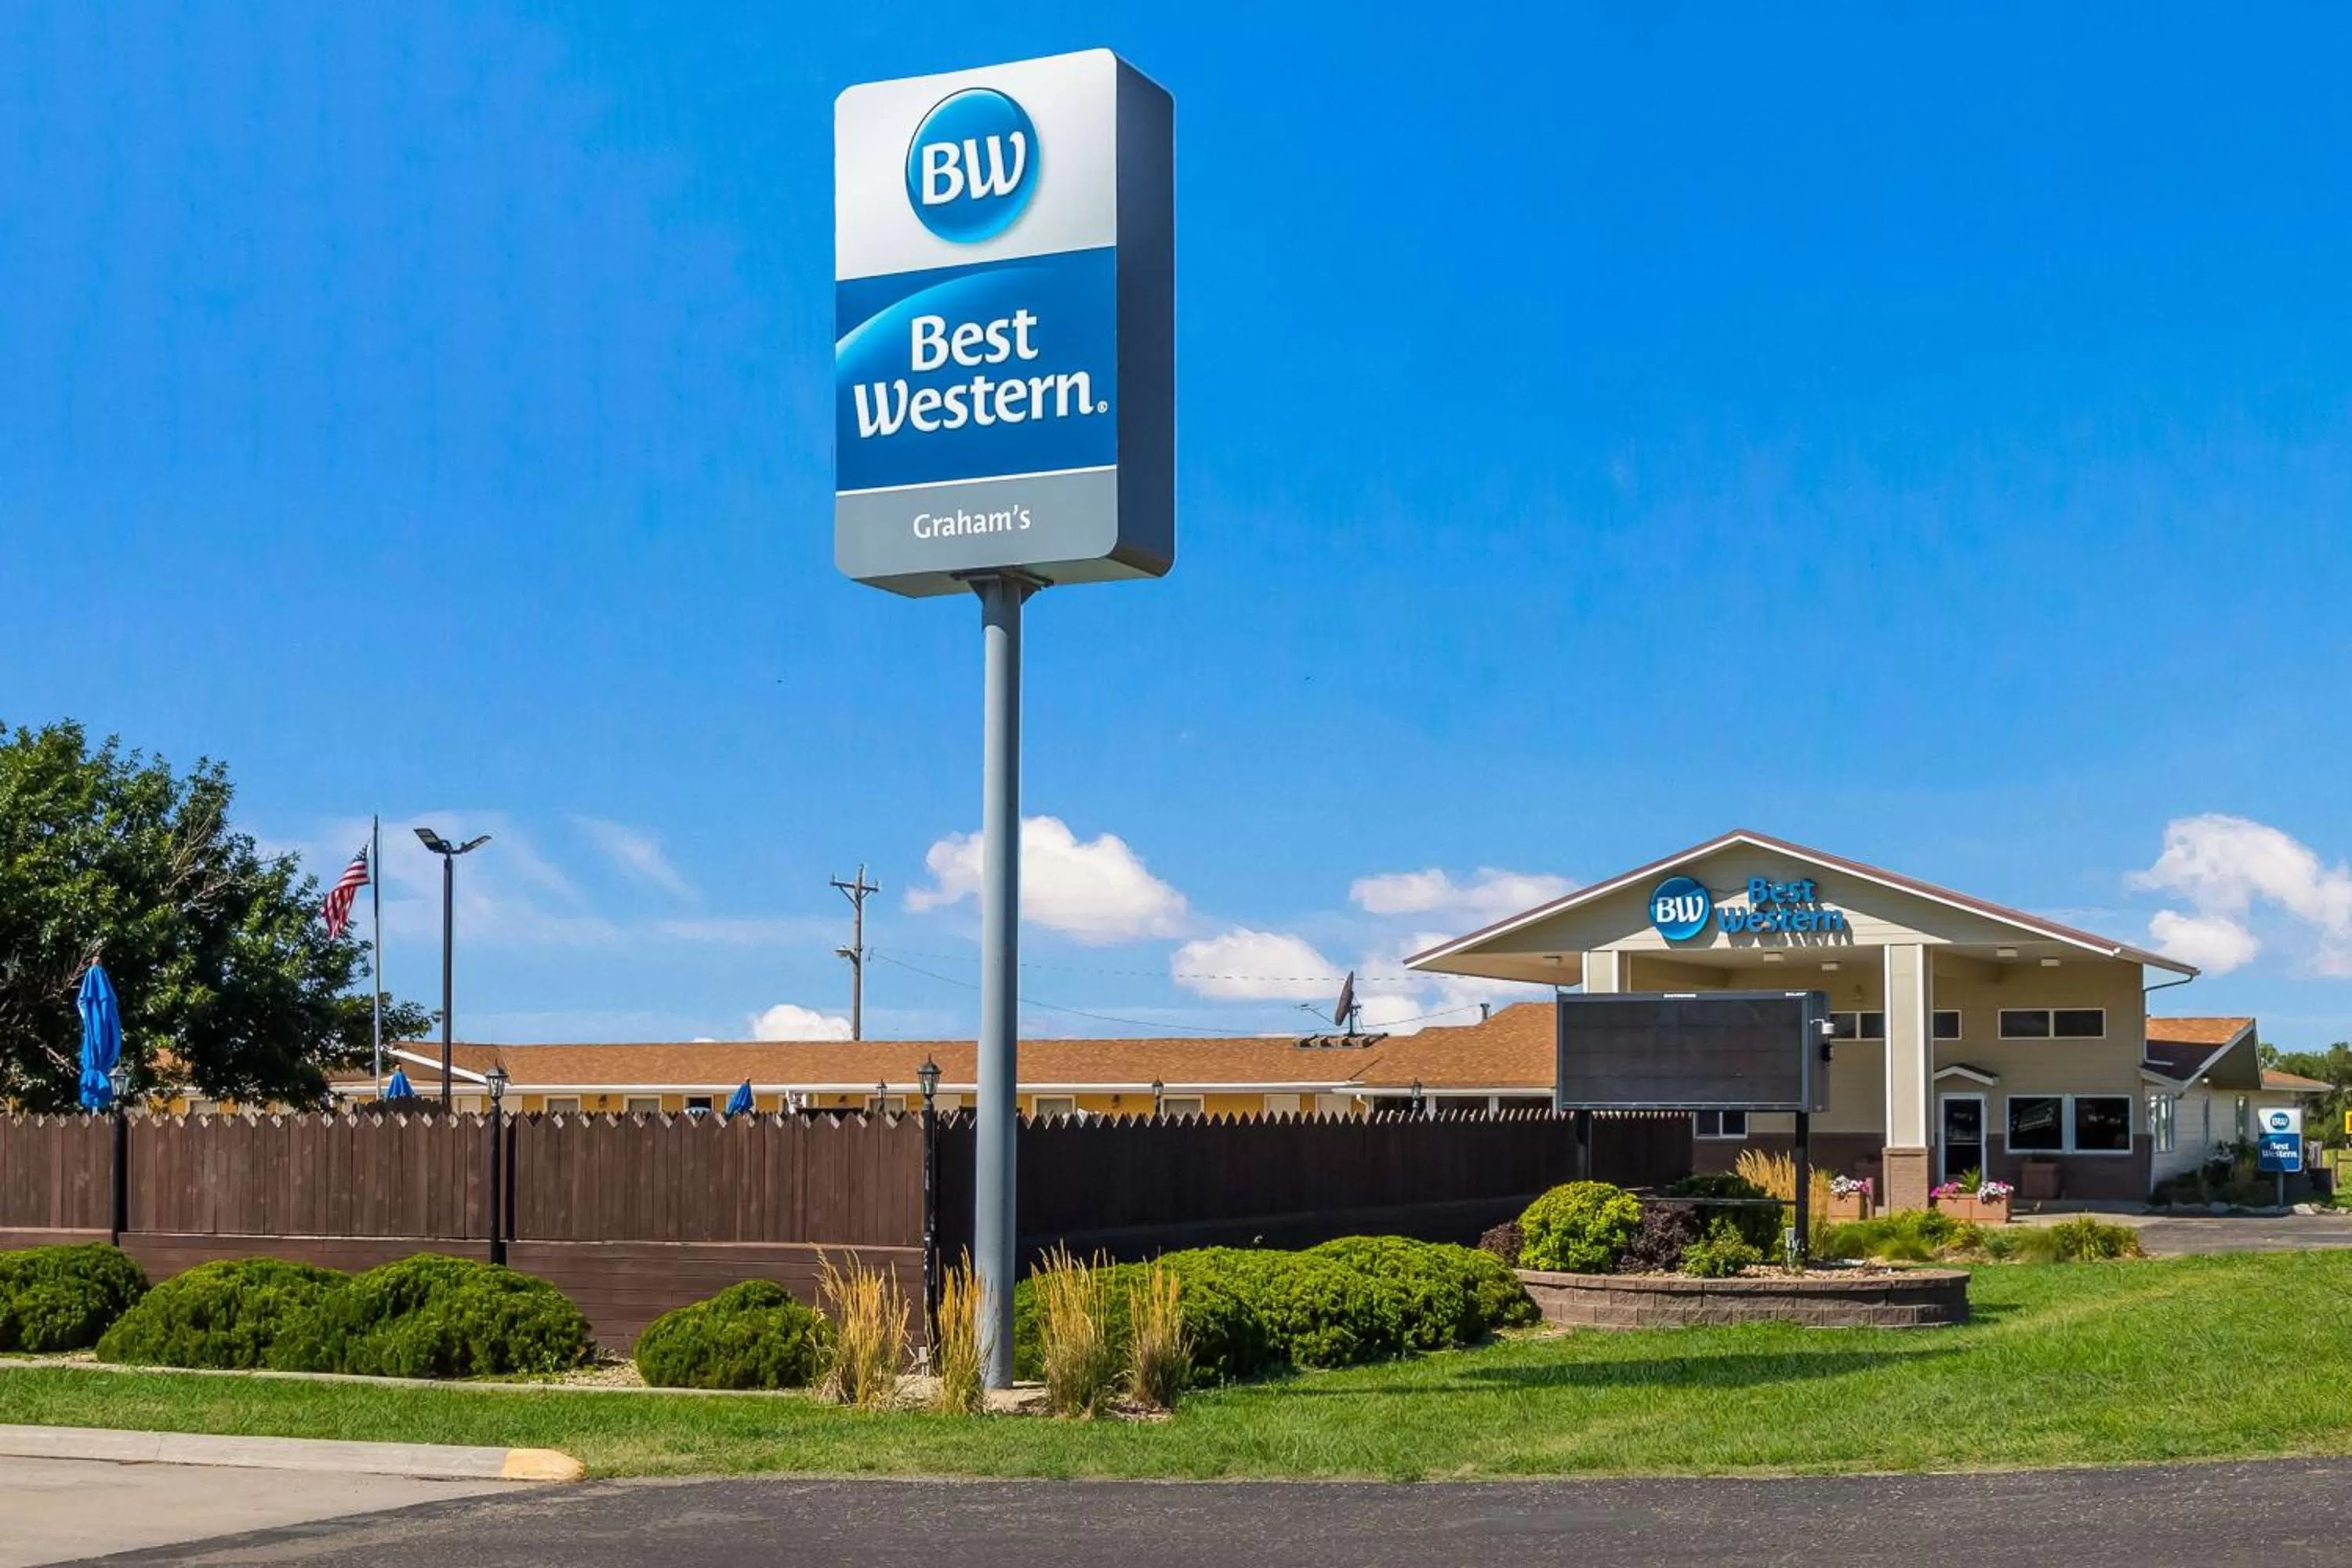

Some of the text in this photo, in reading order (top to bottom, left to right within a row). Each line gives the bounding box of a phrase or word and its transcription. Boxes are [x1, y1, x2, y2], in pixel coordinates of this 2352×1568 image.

[922, 131, 1026, 205] BW
[911, 309, 1039, 372] Best
[913, 504, 1032, 539] Graham's
[1747, 877, 1817, 904] Best
[1656, 895, 1704, 924] BW
[1716, 906, 1844, 934] Western
